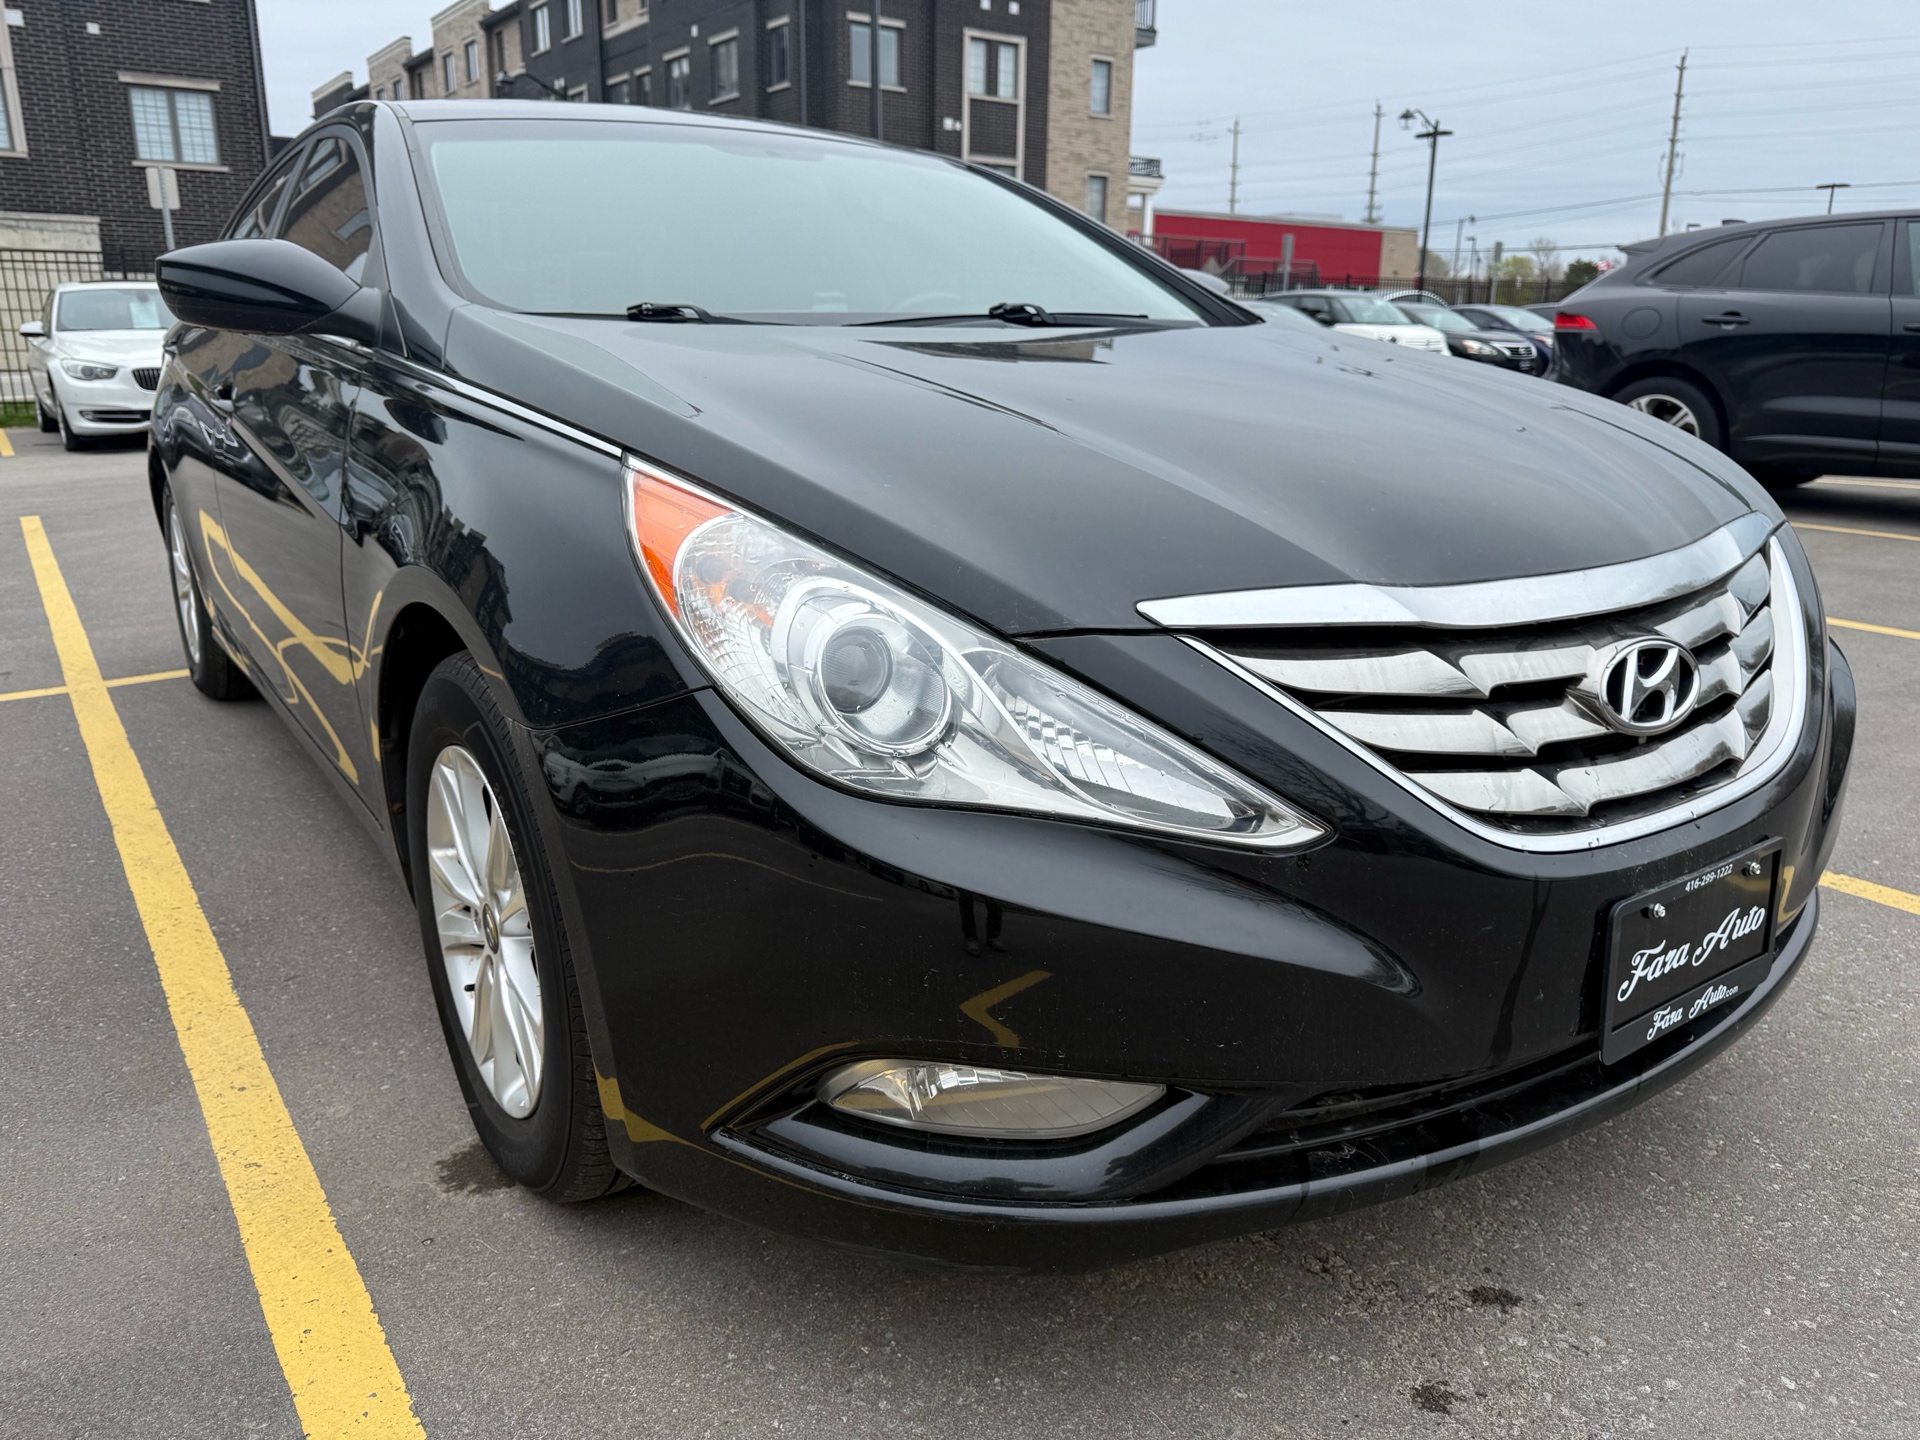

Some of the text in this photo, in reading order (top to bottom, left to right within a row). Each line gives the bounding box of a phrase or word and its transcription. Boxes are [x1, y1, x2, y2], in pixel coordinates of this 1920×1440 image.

[1685, 863, 1733, 892] 416-299-1222
[1617, 905, 1766, 1002] Fara Auto
[1646, 1005, 1683, 1040] Fara
